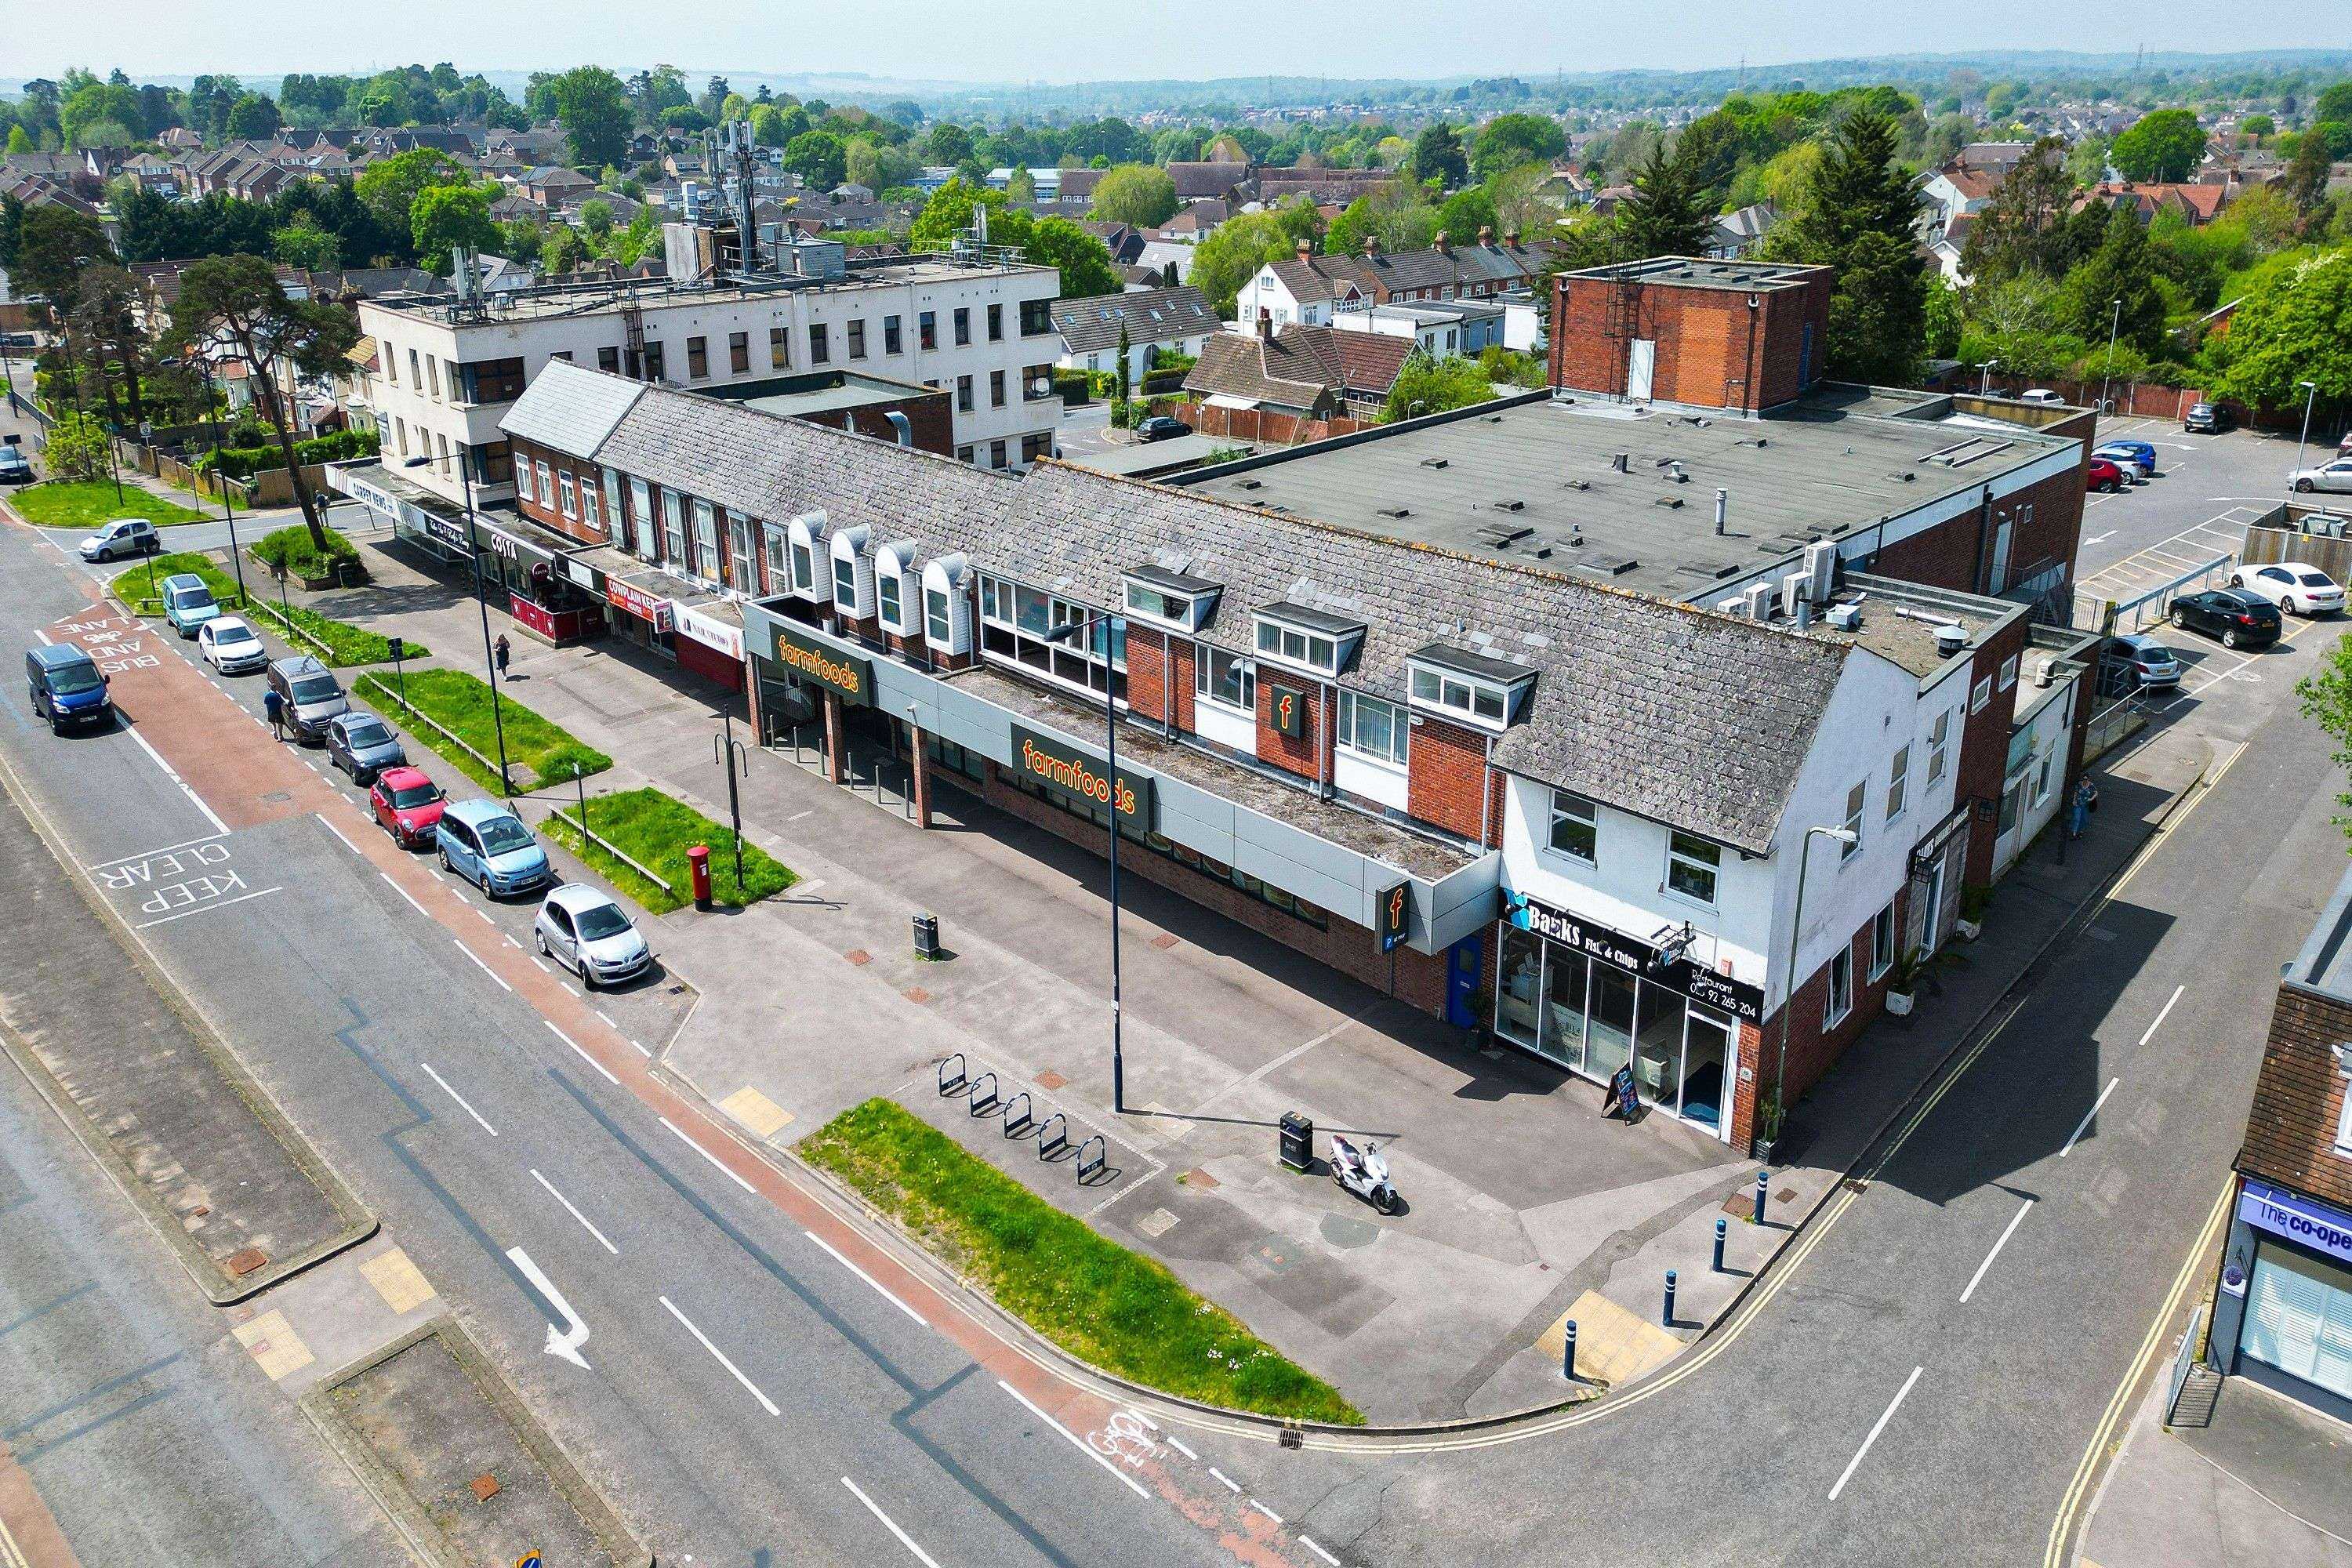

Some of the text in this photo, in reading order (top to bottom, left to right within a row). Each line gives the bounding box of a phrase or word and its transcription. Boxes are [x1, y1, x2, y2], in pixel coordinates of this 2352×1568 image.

[491, 534, 517, 561] COSTA
[608, 579, 642, 607] COWPLAIN
[56, 617, 129, 635] LANE
[88, 641, 140, 659] AND
[100, 655, 160, 673] BUS
[779, 634, 858, 693] farmfoods
[1279, 695, 1292, 729] f
[1022, 739, 1135, 815] farmfoods
[99, 844, 231, 889] CLEAR
[141, 869, 248, 913] KEEP
[1390, 888, 1403, 929] f
[1605, 947, 1612, 959] &
[1614, 949, 1638, 969] Chips
[1708, 989, 1718, 1003] 92
[1721, 995, 1737, 1010] 265
[1739, 1002, 1756, 1018] 204
